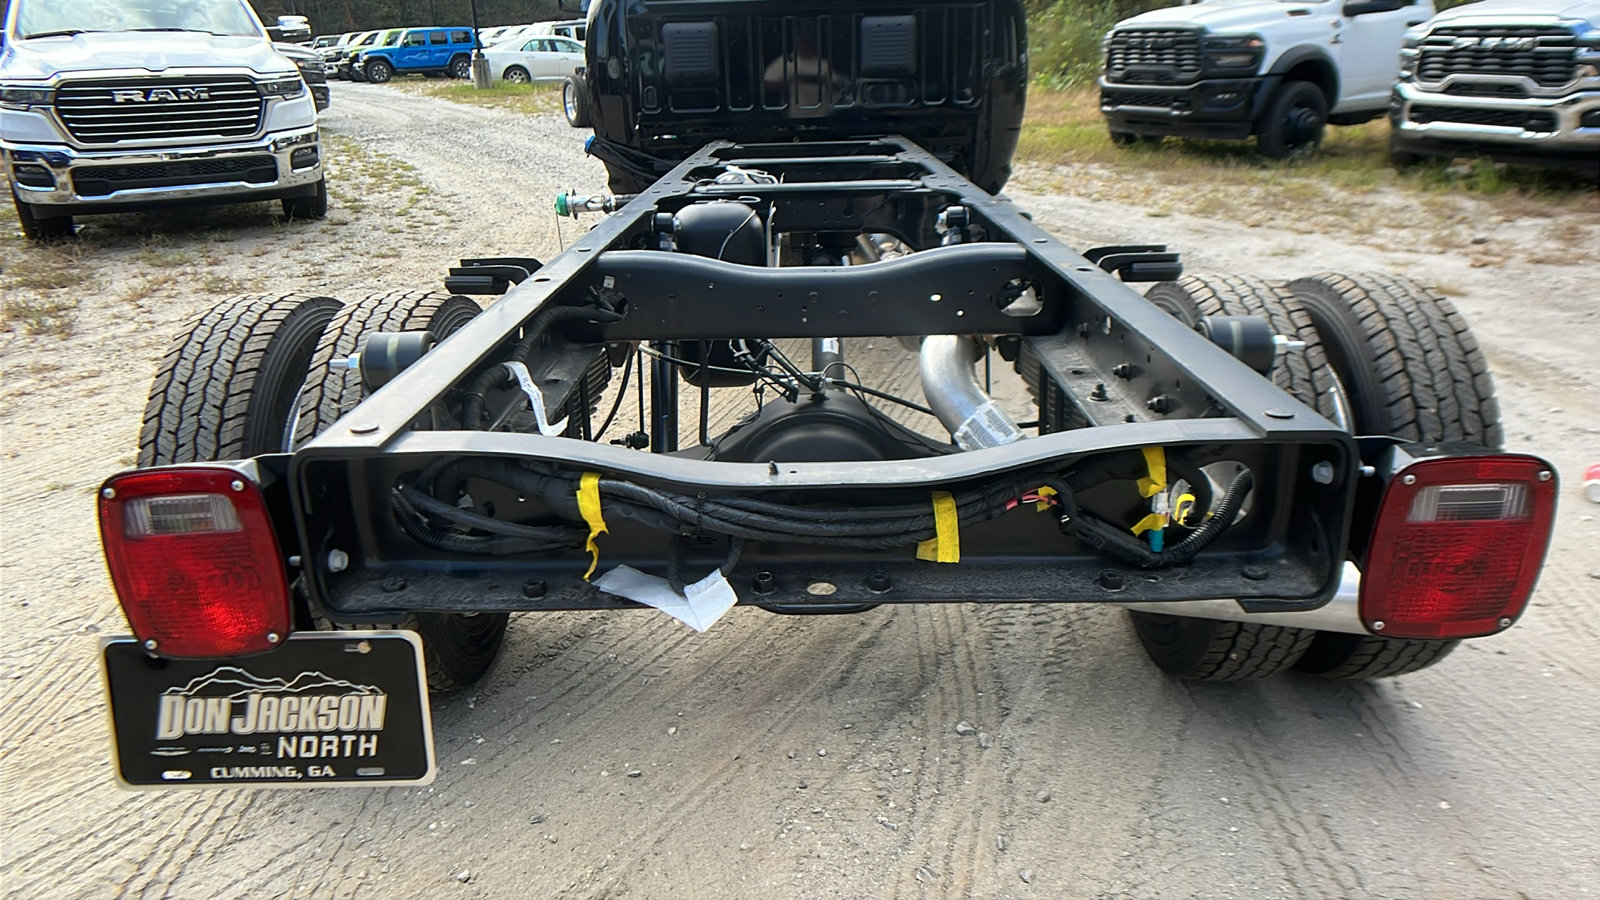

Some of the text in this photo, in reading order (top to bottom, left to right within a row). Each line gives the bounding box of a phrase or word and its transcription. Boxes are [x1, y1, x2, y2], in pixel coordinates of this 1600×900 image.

[112, 88, 210, 102] RAM
[278, 735, 377, 758] NORTH
[210, 766, 336, 779] CUMMING, GA
